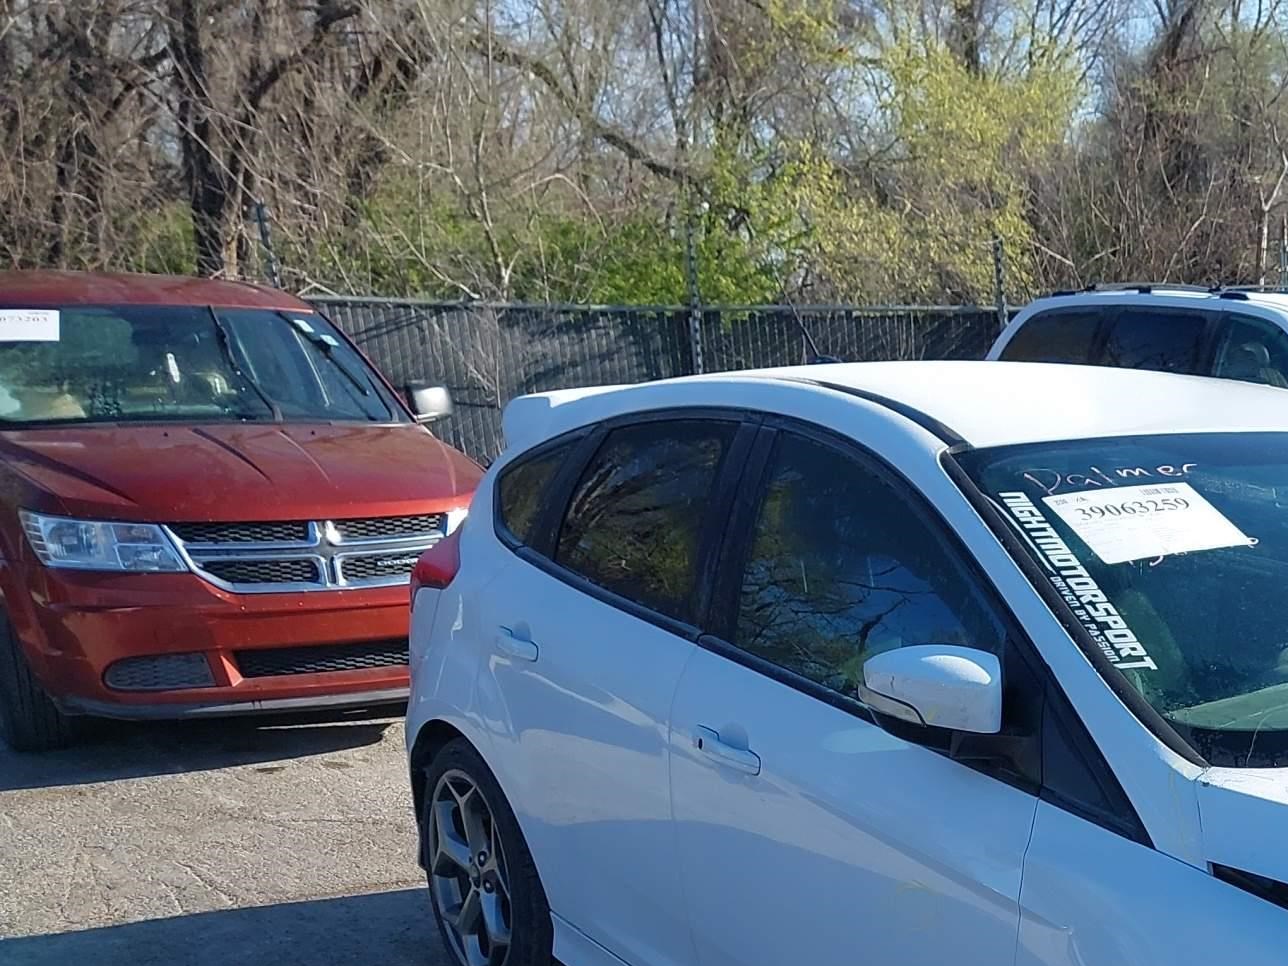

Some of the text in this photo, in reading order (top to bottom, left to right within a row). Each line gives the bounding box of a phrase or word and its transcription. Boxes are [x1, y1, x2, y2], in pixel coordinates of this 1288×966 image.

[1018, 463, 1198, 494] Palmer
[1074, 496, 1191, 521] 39063259
[998, 491, 1159, 672] NIGHTMOTORSPORT
[1049, 575, 1122, 662] DRIVEN BY PASSION
